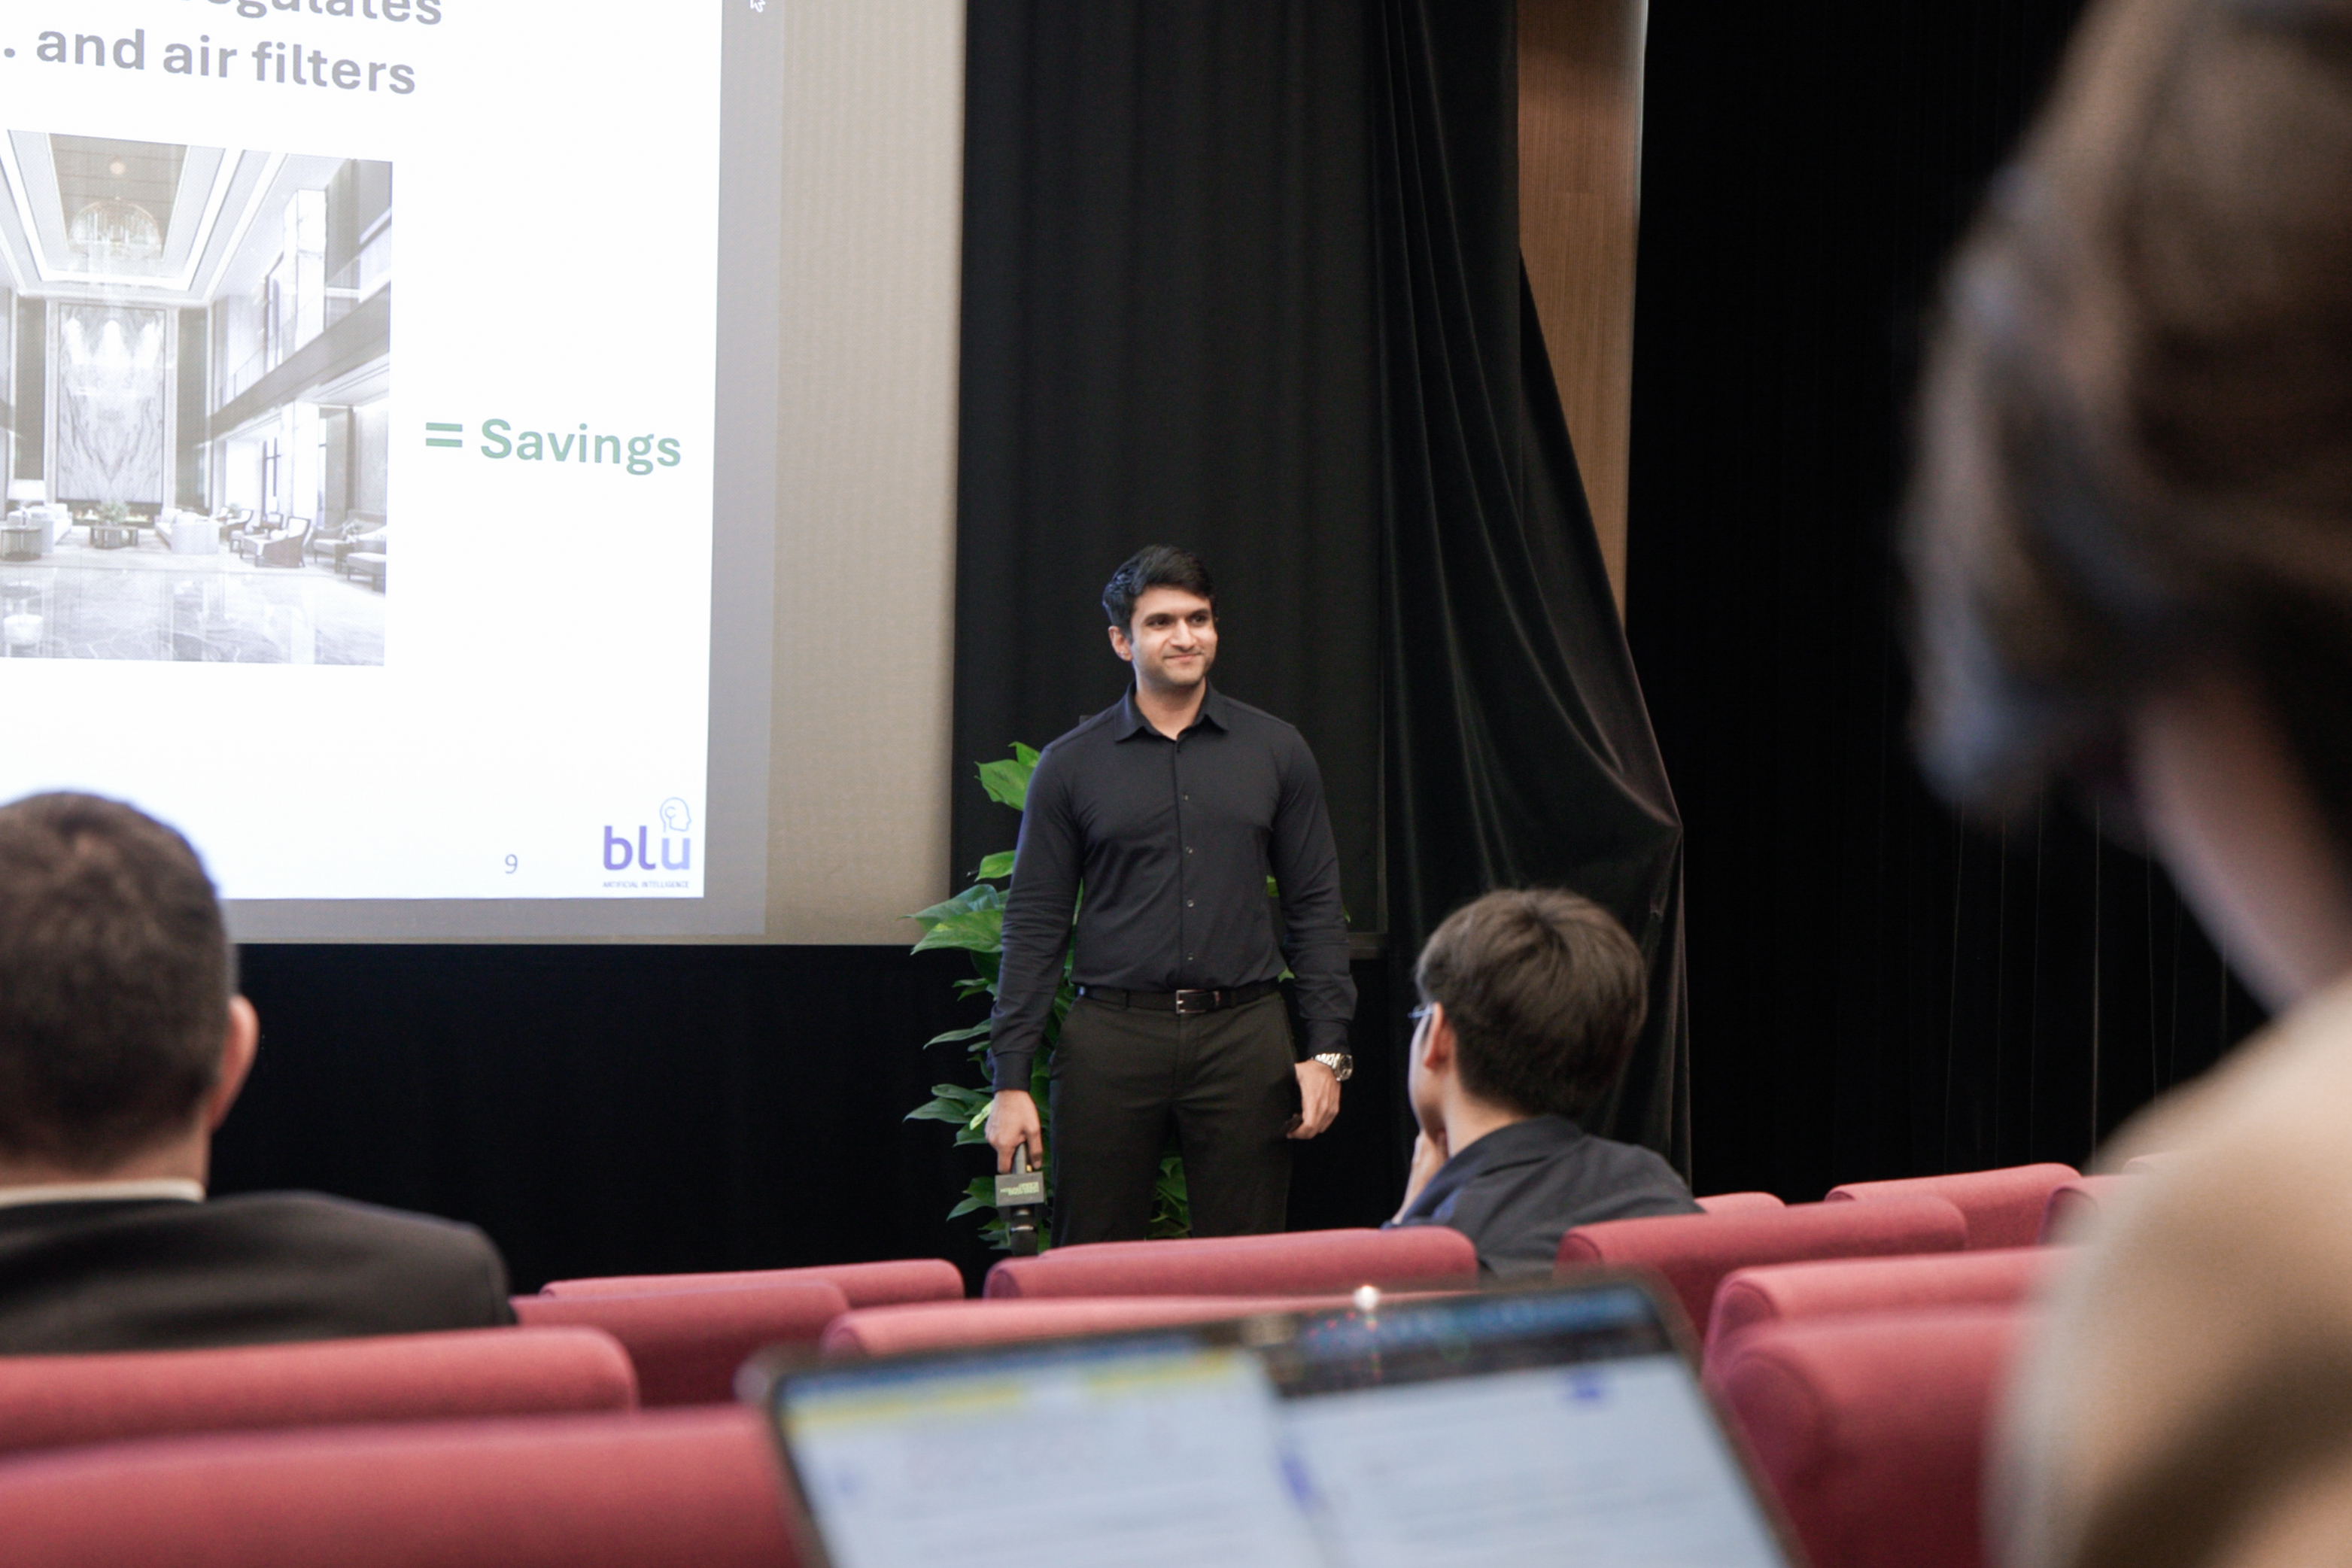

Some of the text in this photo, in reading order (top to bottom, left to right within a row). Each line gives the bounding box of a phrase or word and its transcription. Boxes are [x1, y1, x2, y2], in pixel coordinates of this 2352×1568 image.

[37, 29, 144, 70] and
[163, 35, 238, 78] air
[252, 41, 415, 95] filters
[480, 418, 682, 476] Savings
[505, 853, 518, 874] 9
[603, 825, 691, 871] blu
